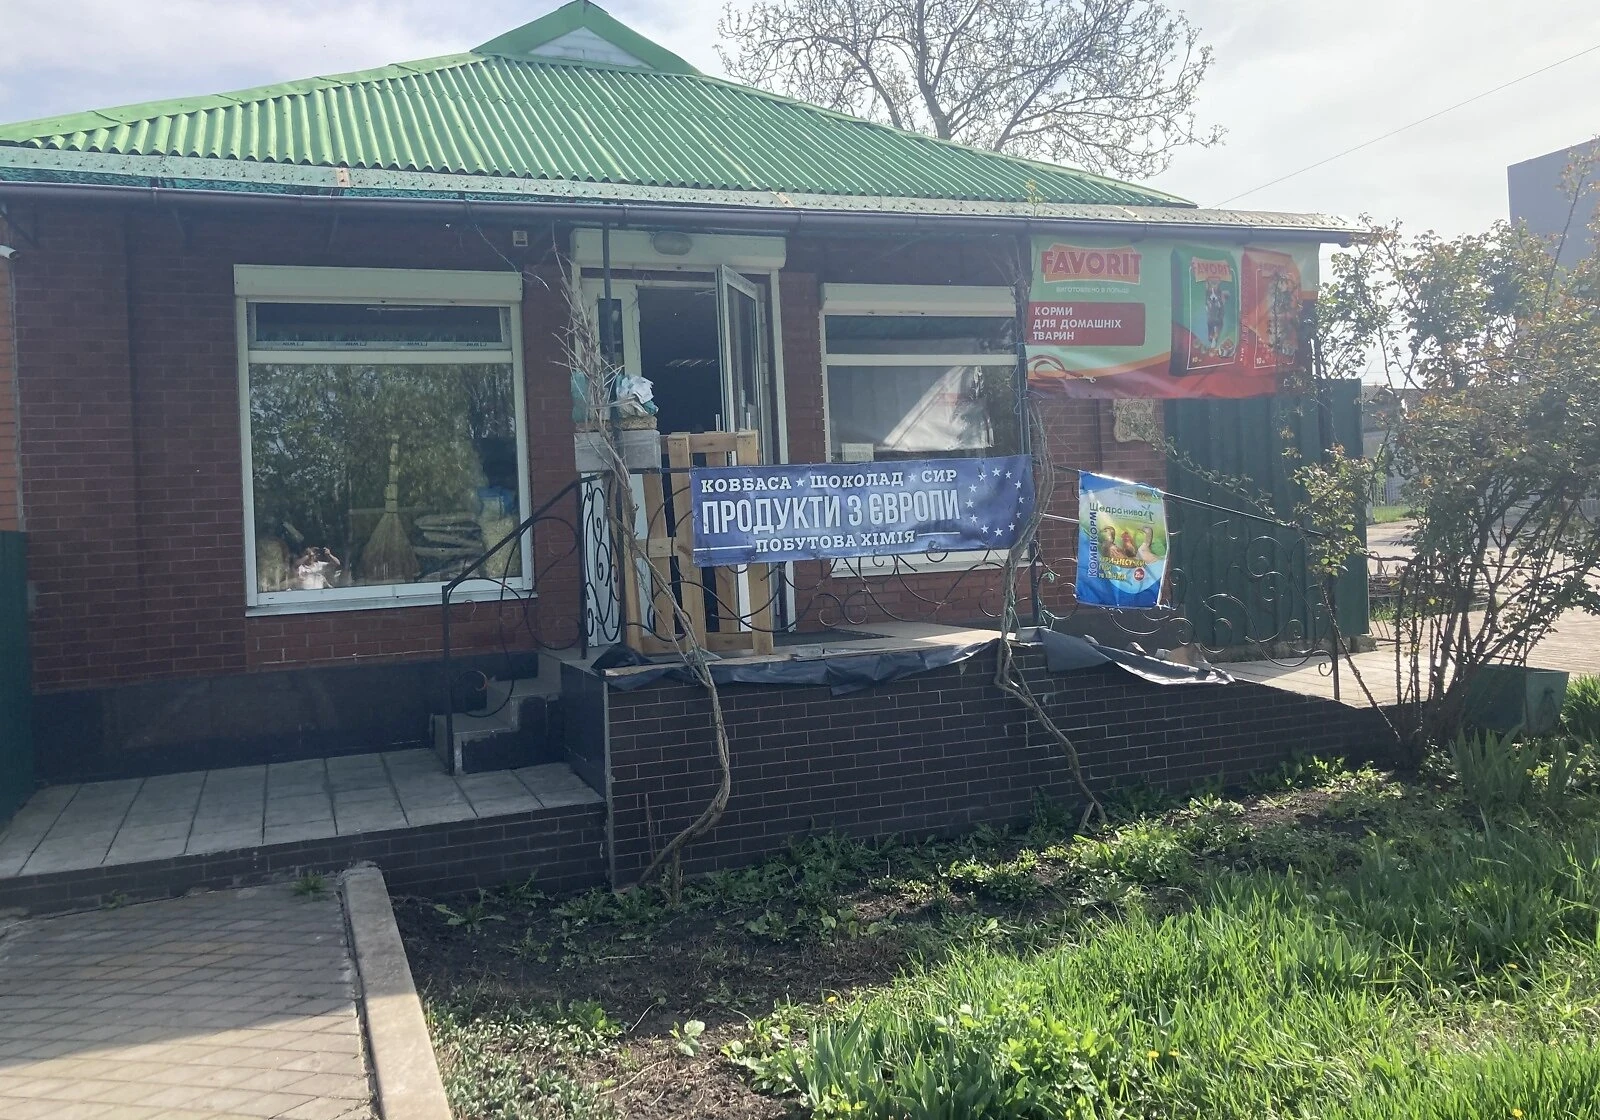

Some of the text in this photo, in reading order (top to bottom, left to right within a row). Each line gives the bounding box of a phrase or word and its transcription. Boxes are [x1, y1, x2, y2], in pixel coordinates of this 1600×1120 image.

[1041, 251, 1142, 276] FAVORIT
[1034, 306, 1073, 316] КОРМИ
[1033, 319, 1122, 330] ДЛЯ ДОМАШНІХ
[1033, 331, 1075, 341] ТВАРИН
[701, 469, 957, 493] КОВБАСА ШОКОЛАД СИР
[702, 495, 841, 535] ПРОДУКТИ
[869, 489, 961, 526] ЄВРОПИ
[755, 529, 915, 553] ПОБУТОВА ХІМІЯ
[1088, 511, 1098, 578] КОМБІКОРМ
